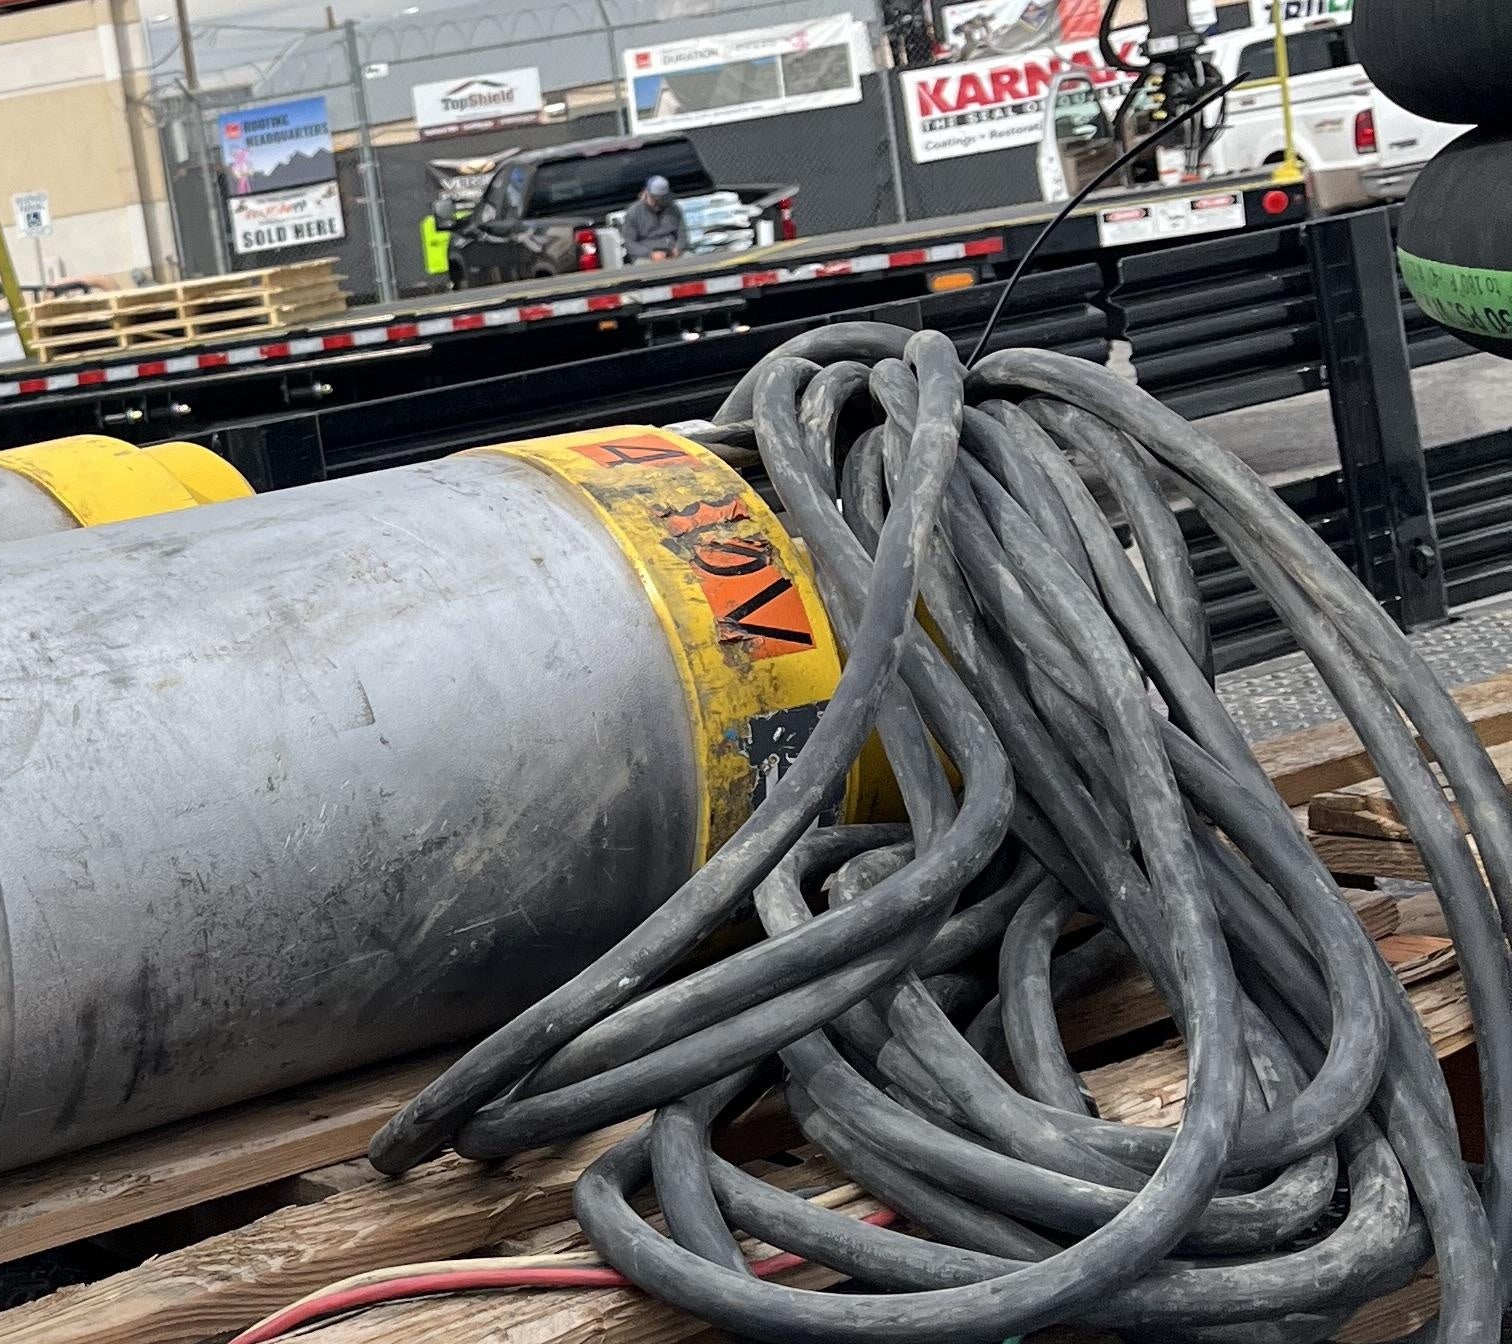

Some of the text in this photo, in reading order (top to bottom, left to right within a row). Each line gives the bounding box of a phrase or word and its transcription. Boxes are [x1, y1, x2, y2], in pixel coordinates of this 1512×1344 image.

[441, 88, 514, 111] TopShield
[242, 226, 287, 248] SOLD
[294, 217, 337, 239] HERE
